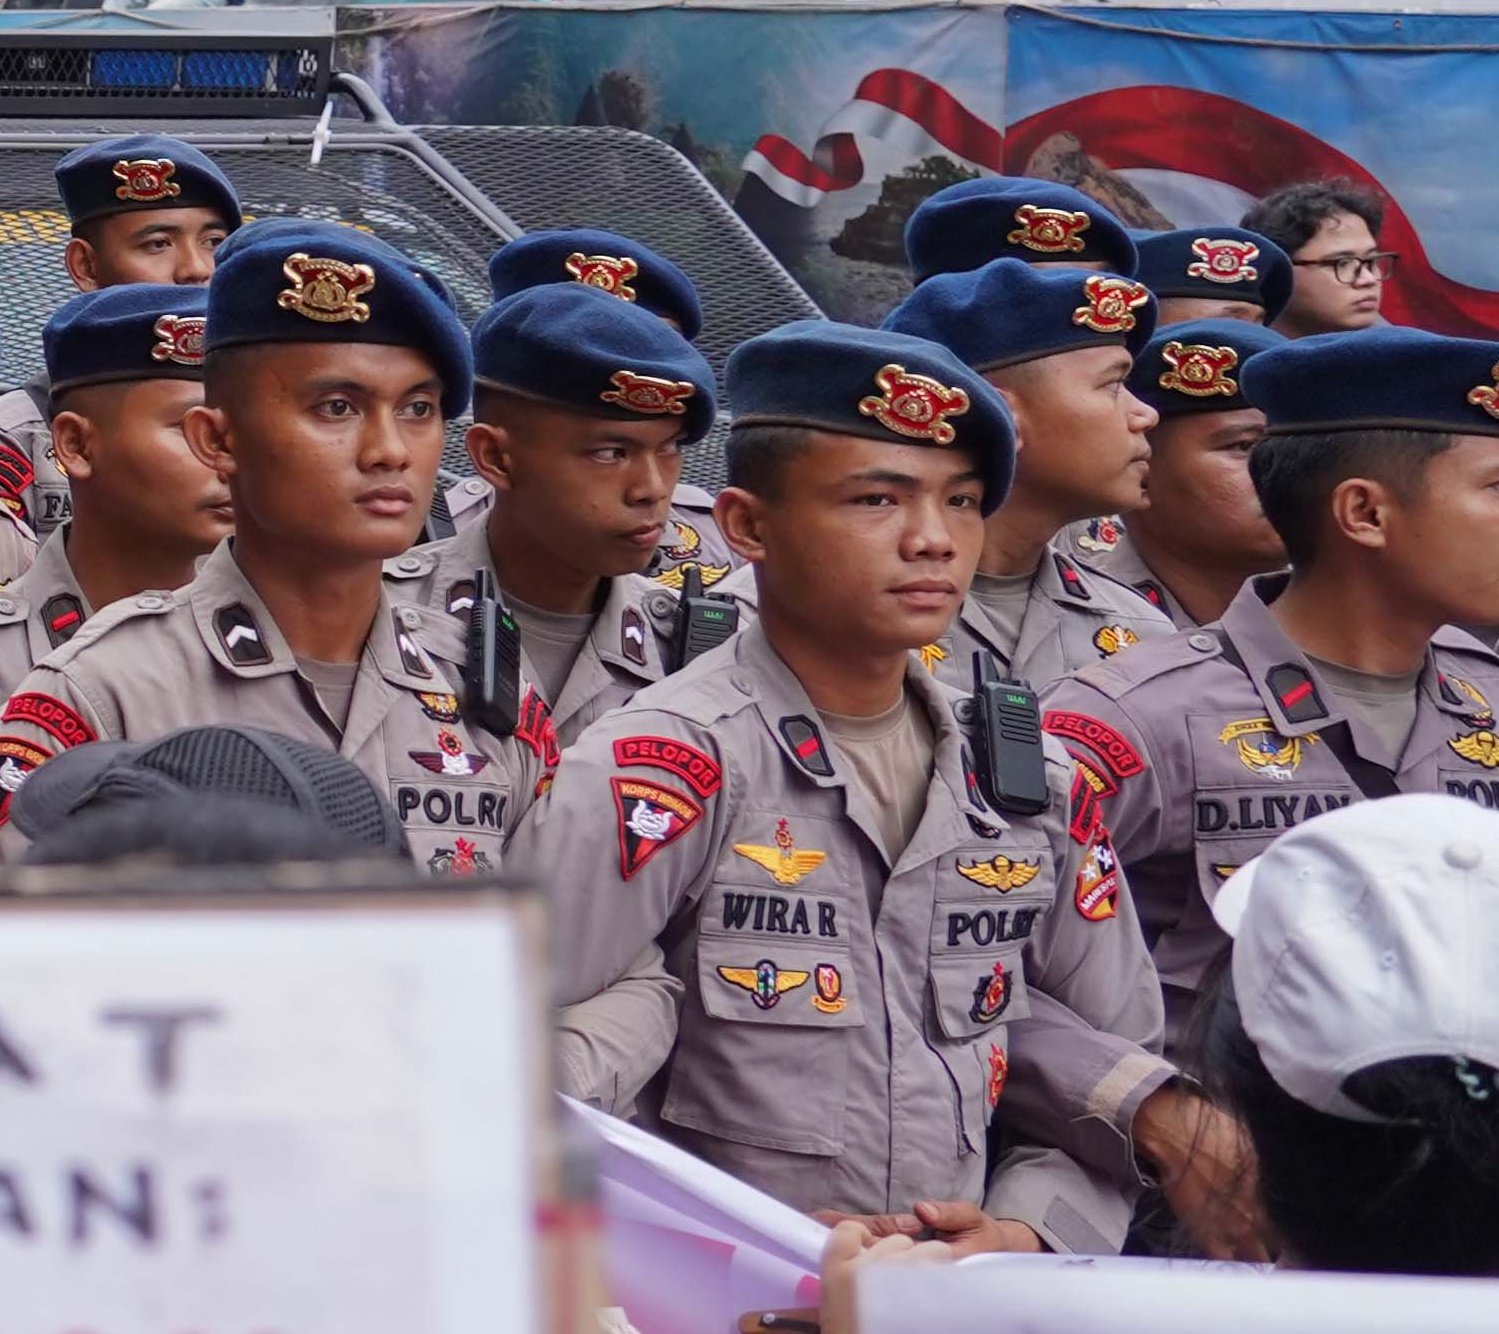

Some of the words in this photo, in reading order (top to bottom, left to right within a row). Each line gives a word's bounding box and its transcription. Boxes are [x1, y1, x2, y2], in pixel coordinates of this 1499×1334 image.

[10, 696, 89, 747] PELOPOR
[1049, 714, 1135, 772] PELOPOR
[626, 741, 714, 788] PELOPOR
[621, 785, 656, 802] KORPS
[721, 891, 813, 936] WIRA
[817, 900, 839, 938] R
